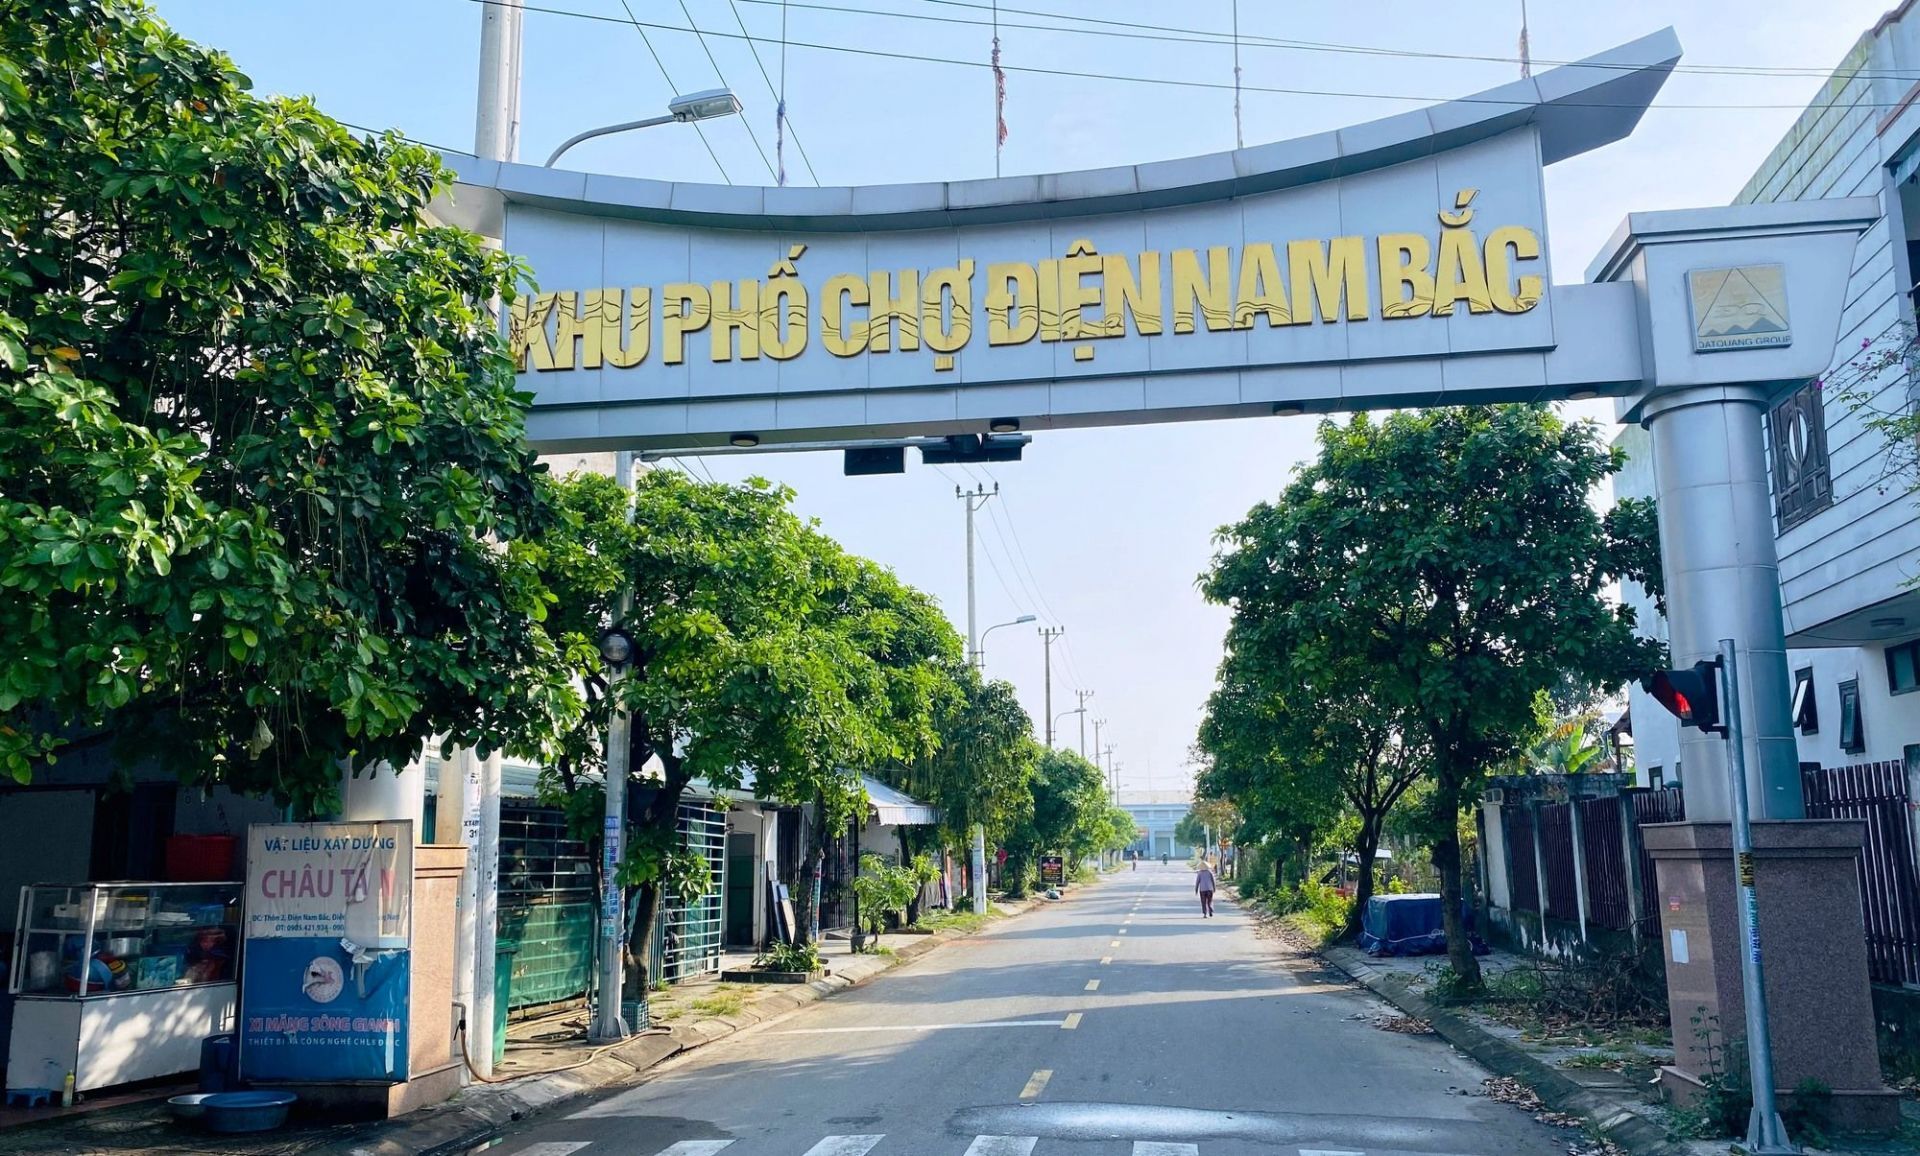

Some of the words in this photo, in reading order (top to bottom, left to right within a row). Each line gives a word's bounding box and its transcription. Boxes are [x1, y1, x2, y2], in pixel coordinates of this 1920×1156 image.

[509, 287, 652, 373] KHU
[663, 244, 808, 365] PHỐ
[821, 259, 975, 371] CHỢ
[984, 239, 1163, 361] ĐIỆN
[1170, 235, 1369, 335] NAM
[1377, 189, 1544, 320] BẮC
[292, 836, 320, 854] LIỆU
[324, 836, 349, 850] XÂY
[262, 863, 334, 899] CHÂU
[249, 1018, 263, 1032] XI
[265, 1014, 309, 1032] MĂNG
[310, 1014, 350, 1032] SÔNG
